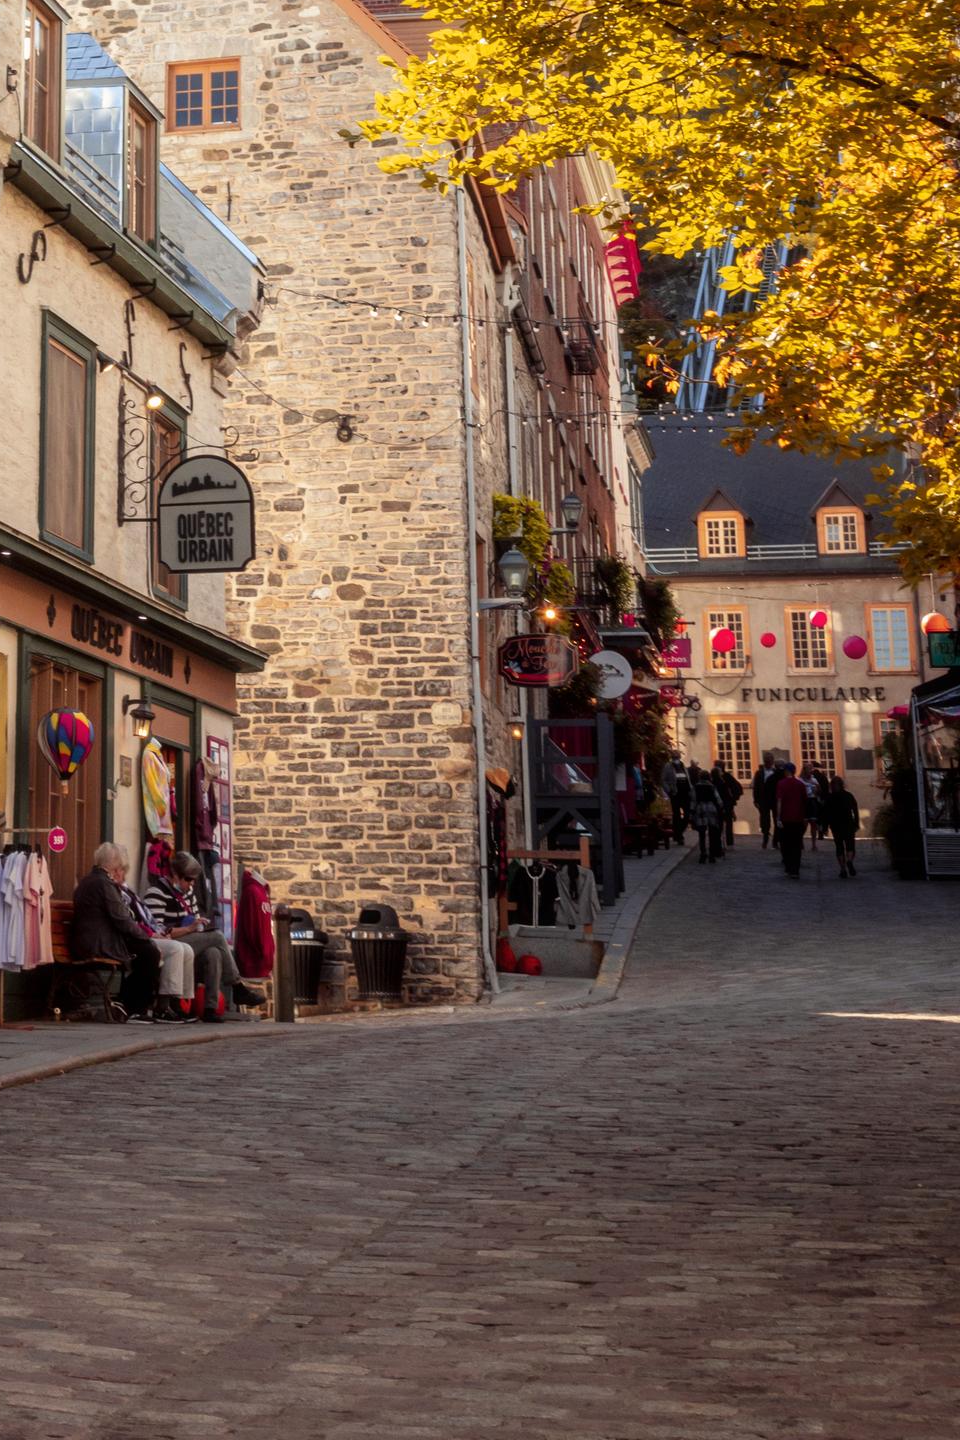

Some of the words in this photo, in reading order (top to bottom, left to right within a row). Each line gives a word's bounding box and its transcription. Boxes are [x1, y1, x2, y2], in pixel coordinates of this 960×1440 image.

[177, 510, 234, 539] QUÉBEC
[177, 539, 234, 563] URBAIN
[71, 604, 123, 657] QUÉBEC
[129, 630, 174, 678] URBAIN
[742, 686, 886, 702] FUNICULAIRE
